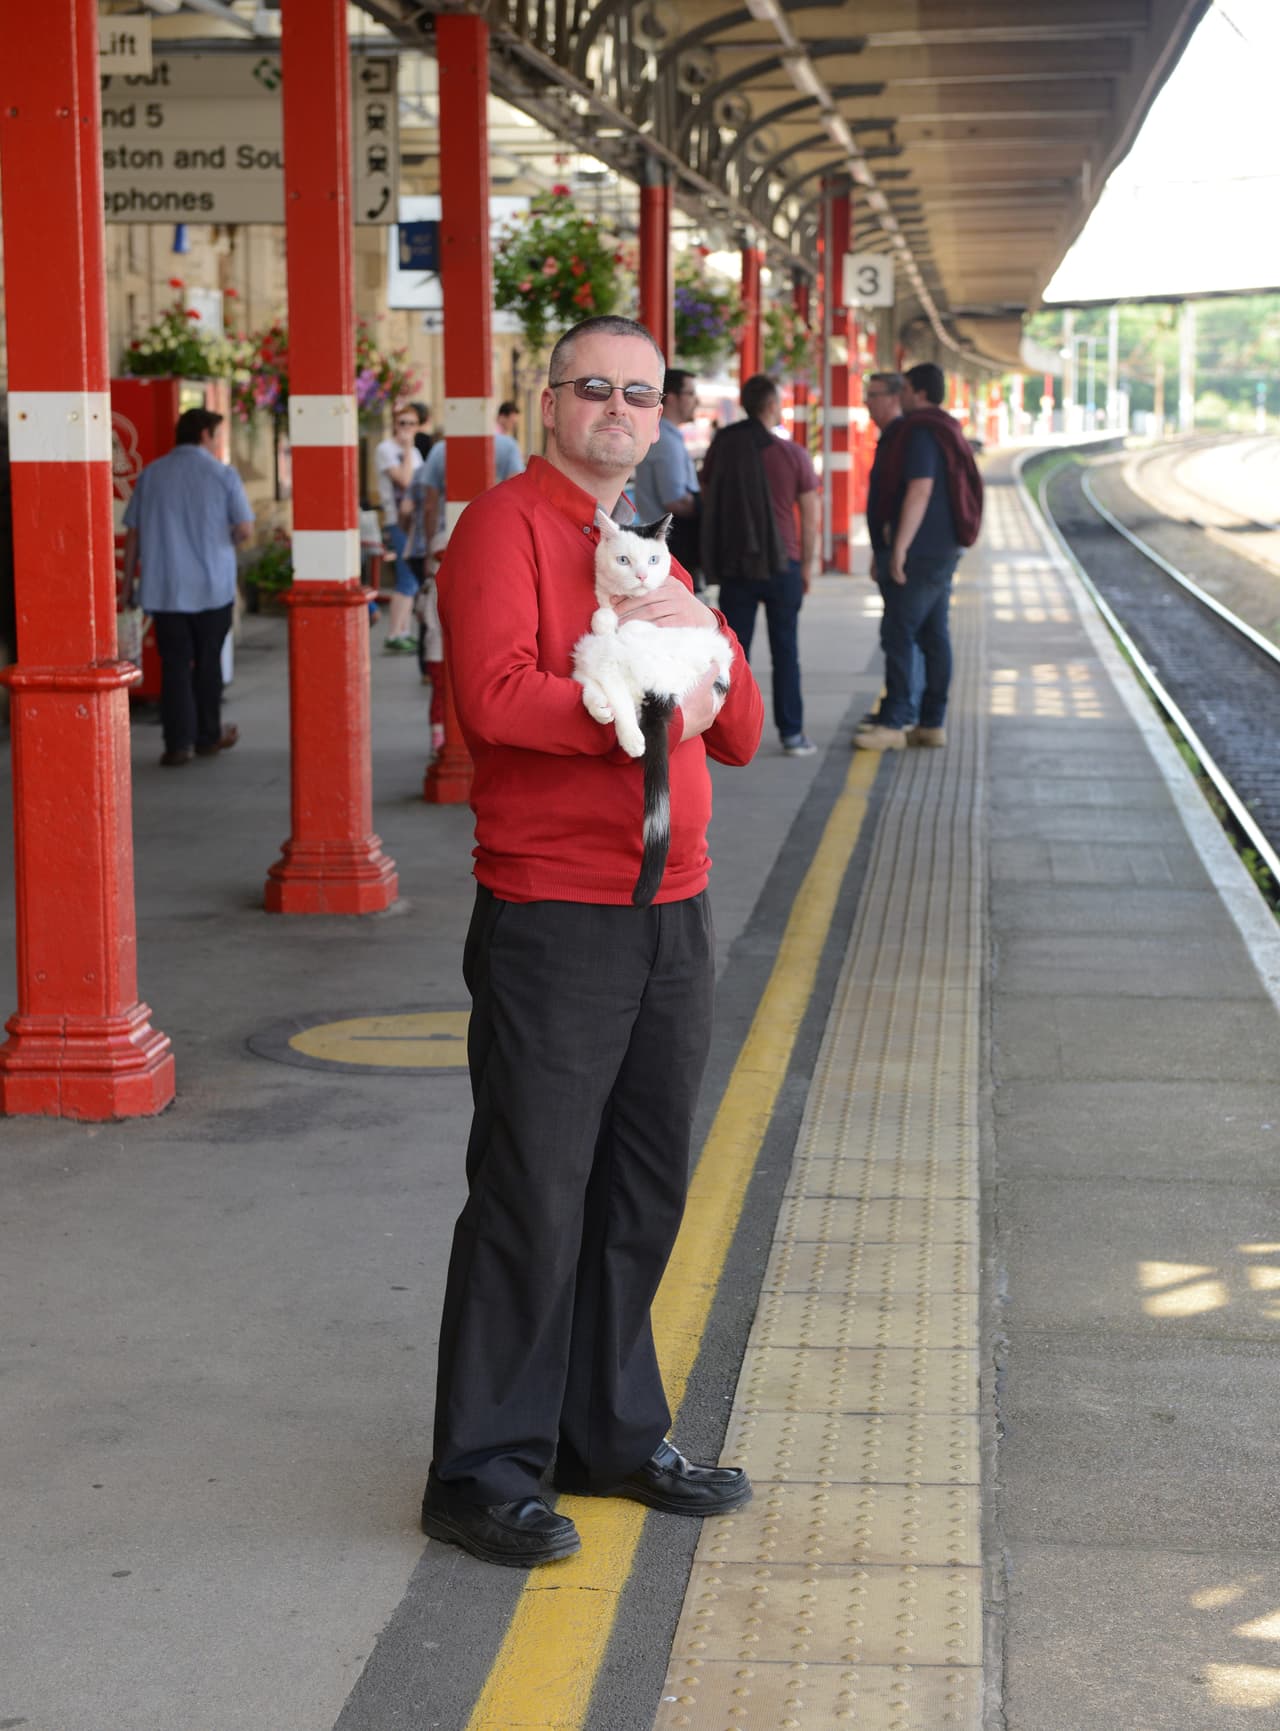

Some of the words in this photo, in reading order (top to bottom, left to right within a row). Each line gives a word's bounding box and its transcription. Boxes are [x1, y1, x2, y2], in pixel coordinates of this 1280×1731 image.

[145, 104, 163, 129] 5
[174, 146, 226, 169] and
[857, 266, 879, 296] 3
